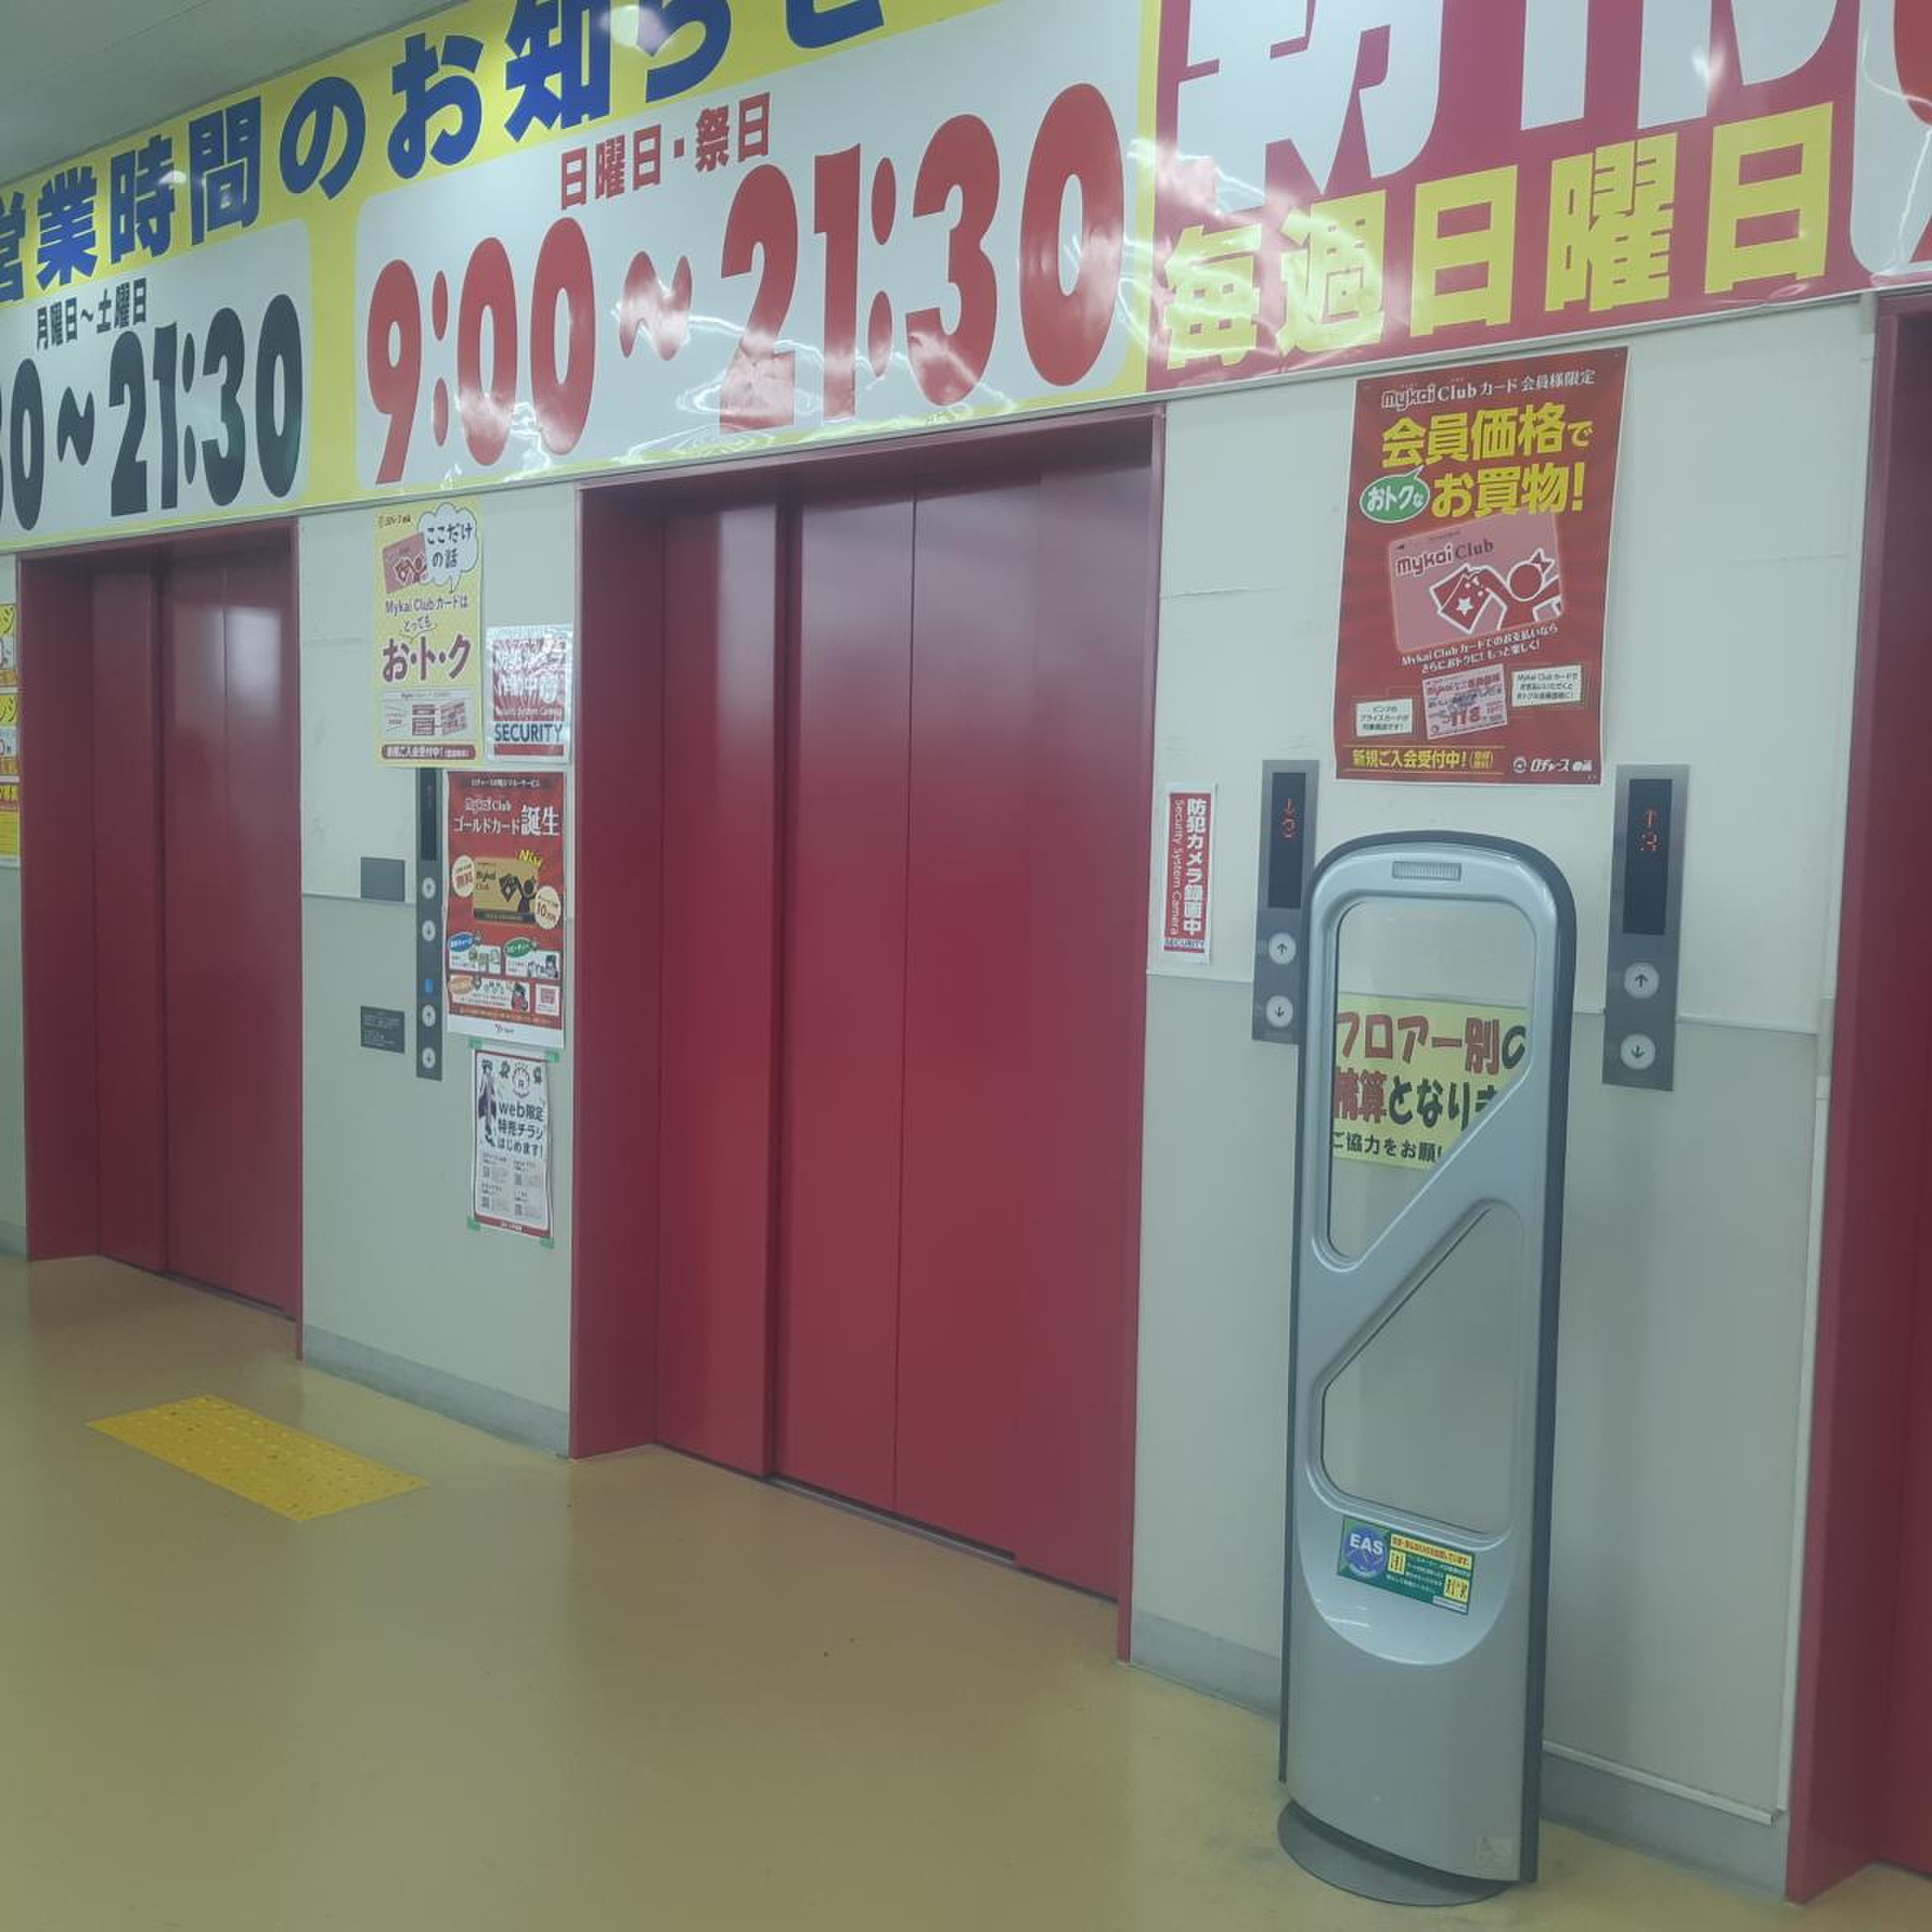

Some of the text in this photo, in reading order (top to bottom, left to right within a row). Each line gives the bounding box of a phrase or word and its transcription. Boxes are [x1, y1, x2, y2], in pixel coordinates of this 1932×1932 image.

[0, 0, 885, 303] 業時間のお知ら
[1164, 101, 1834, 370] 毎週日曜日
[1437, 379, 1477, 402] Club
[1480, 377, 1518, 396] カード
[1381, 401, 1593, 469] 会員価格で
[1367, 485, 1425, 513] おトクな
[427, 522, 473, 545] ここだけ
[431, 547, 459, 569] の話
[1396, 538, 1495, 577] mykai Club
[493, 723, 564, 742] SECURITY
[1349, 1532, 1384, 1555] EAS
